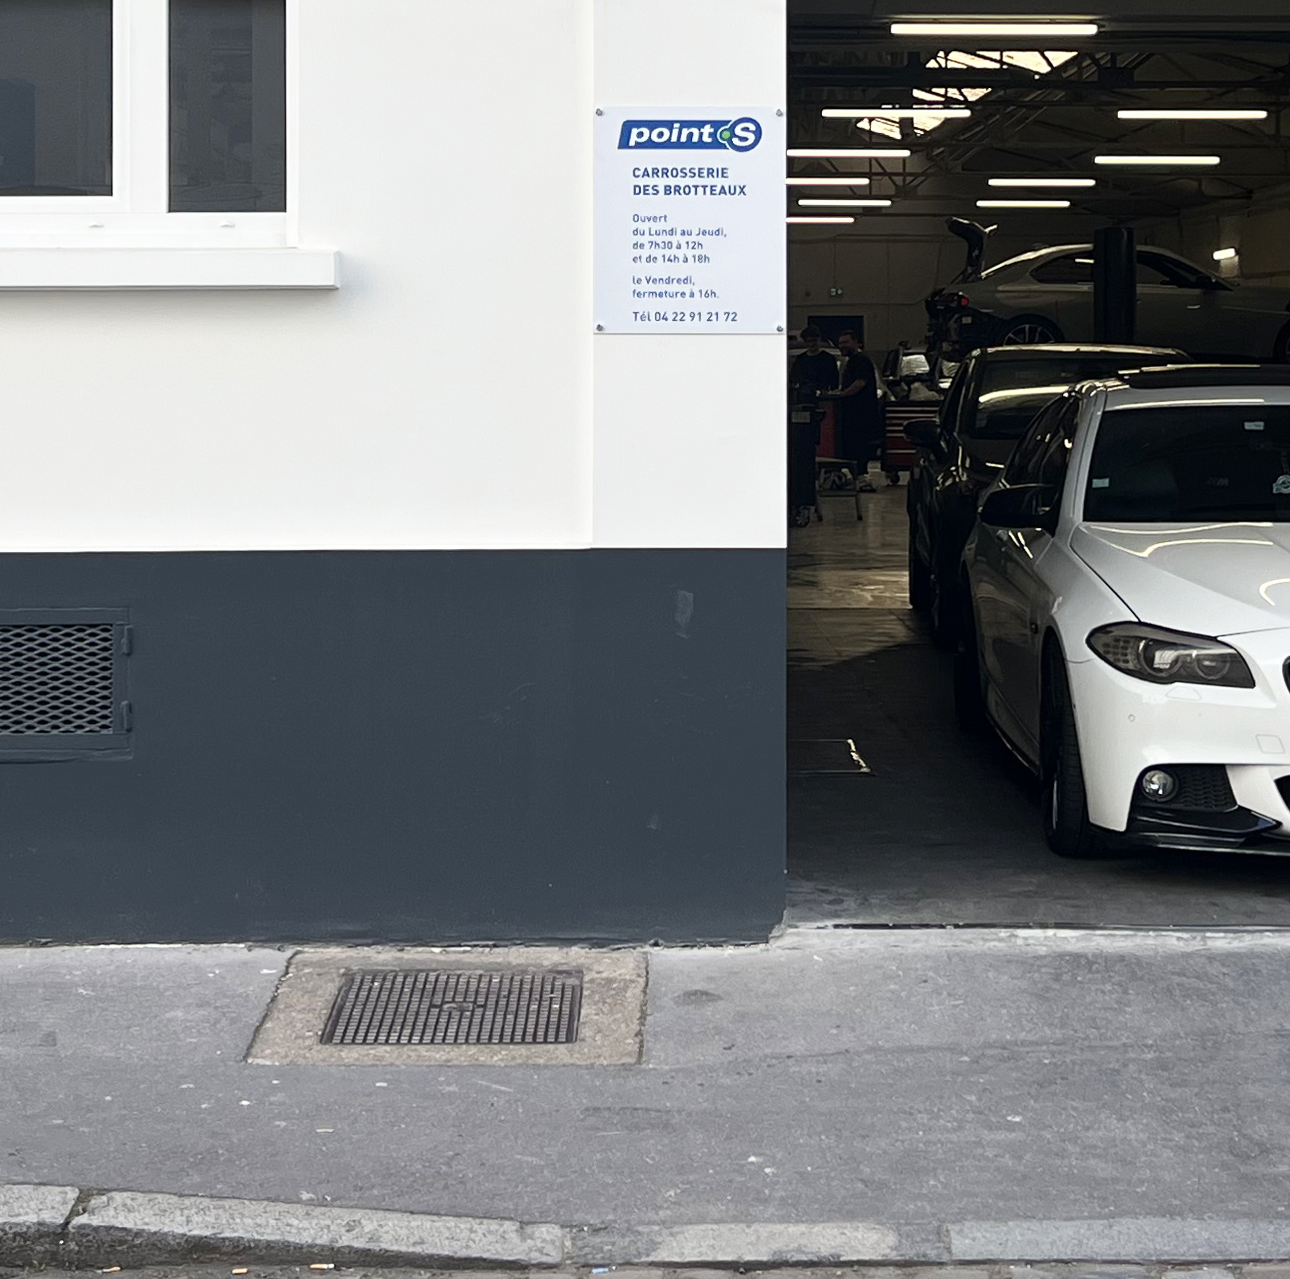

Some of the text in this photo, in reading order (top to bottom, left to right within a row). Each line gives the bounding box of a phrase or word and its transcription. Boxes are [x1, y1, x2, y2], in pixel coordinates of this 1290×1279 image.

[628, 122, 757, 147] point S
[632, 167, 730, 179] CARROSSERIE
[632, 184, 747, 196] DES BROTTEAUX
[632, 213, 668, 223] Ouvert
[632, 227, 728, 237] du Lundi au Jeudi,
[632, 240, 703, 250] de 7h30 à 12h
[632, 254, 710, 264] et de 14h à 18h
[632, 276, 695, 286] le Vendredi,
[632, 289, 720, 299] fermeture à 16h.
[632, 311, 738, 322] Tél 04 22 91 21 72
